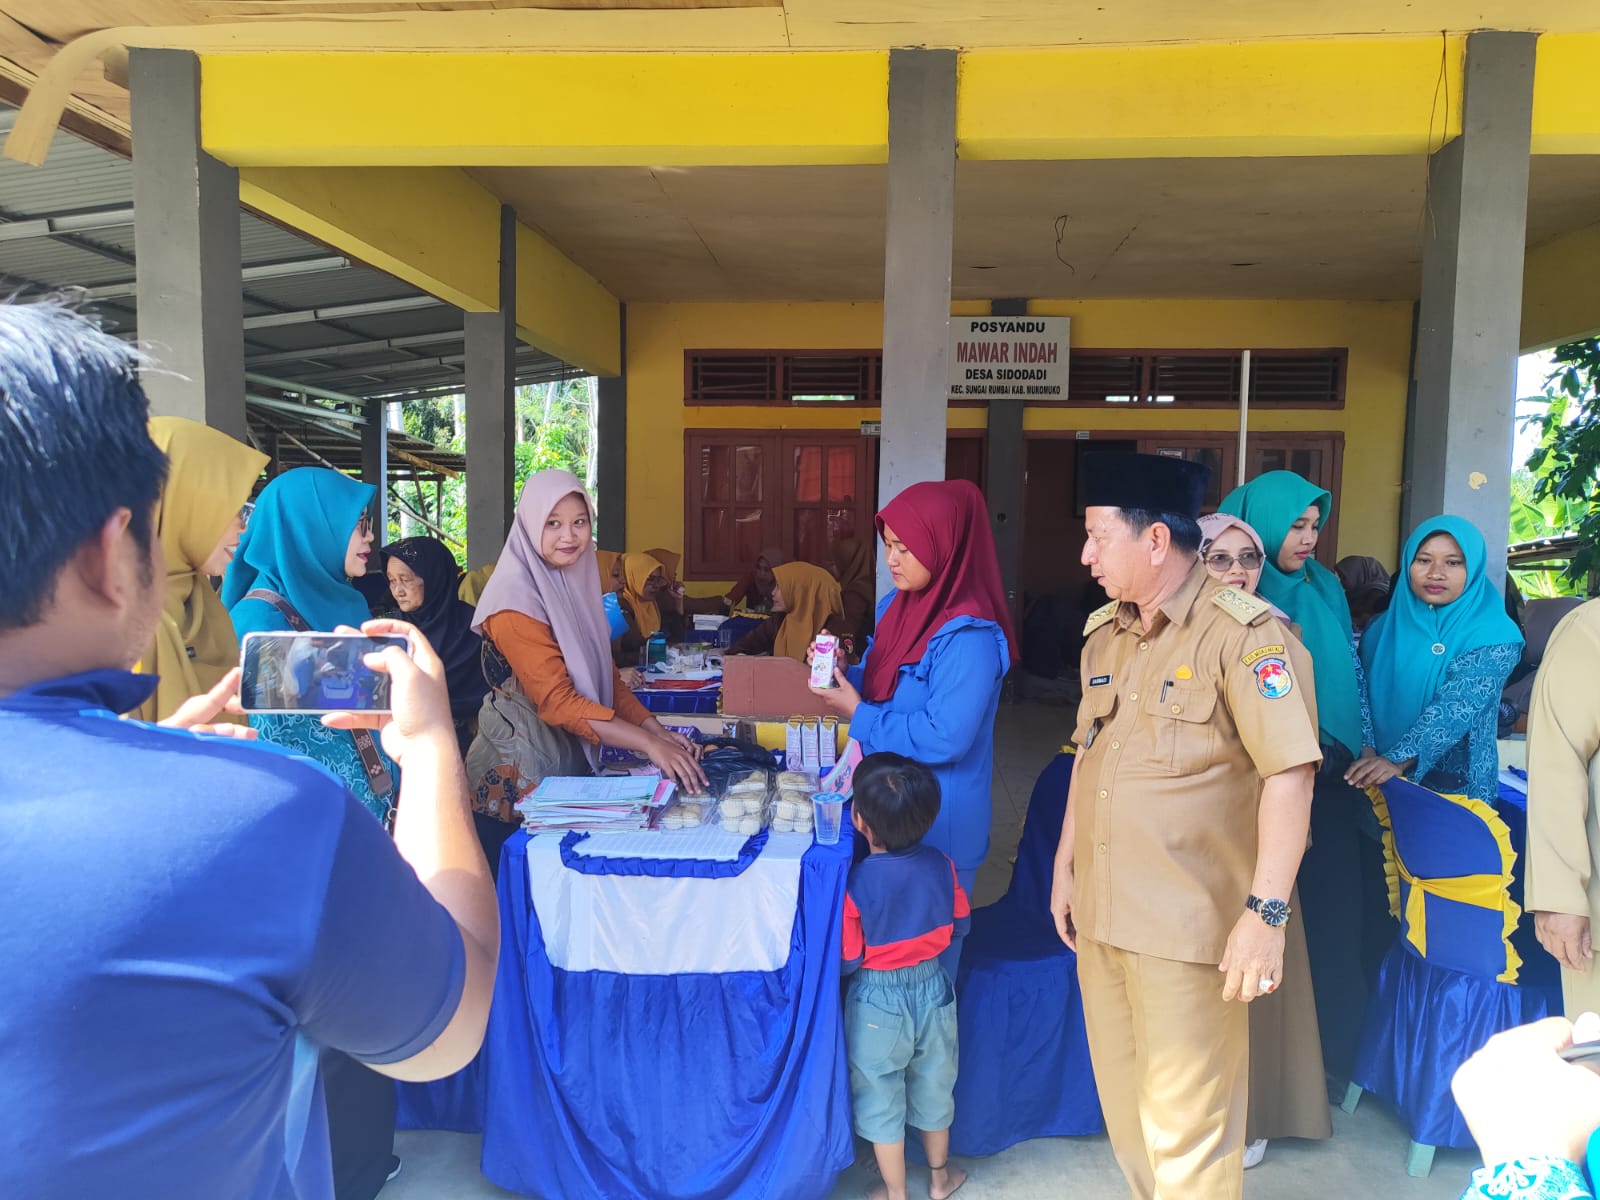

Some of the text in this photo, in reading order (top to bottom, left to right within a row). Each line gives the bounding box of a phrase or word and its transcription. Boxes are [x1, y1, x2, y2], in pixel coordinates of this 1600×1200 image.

[970, 322, 1045, 333] POSYANDU
[957, 342, 1058, 363] MAWAR INDAH
[965, 369, 1047, 380] DESA SIDODADI
[951, 384, 1061, 395] KEC. SUNGAI RUMBAI KAB. MUKOMUKO
